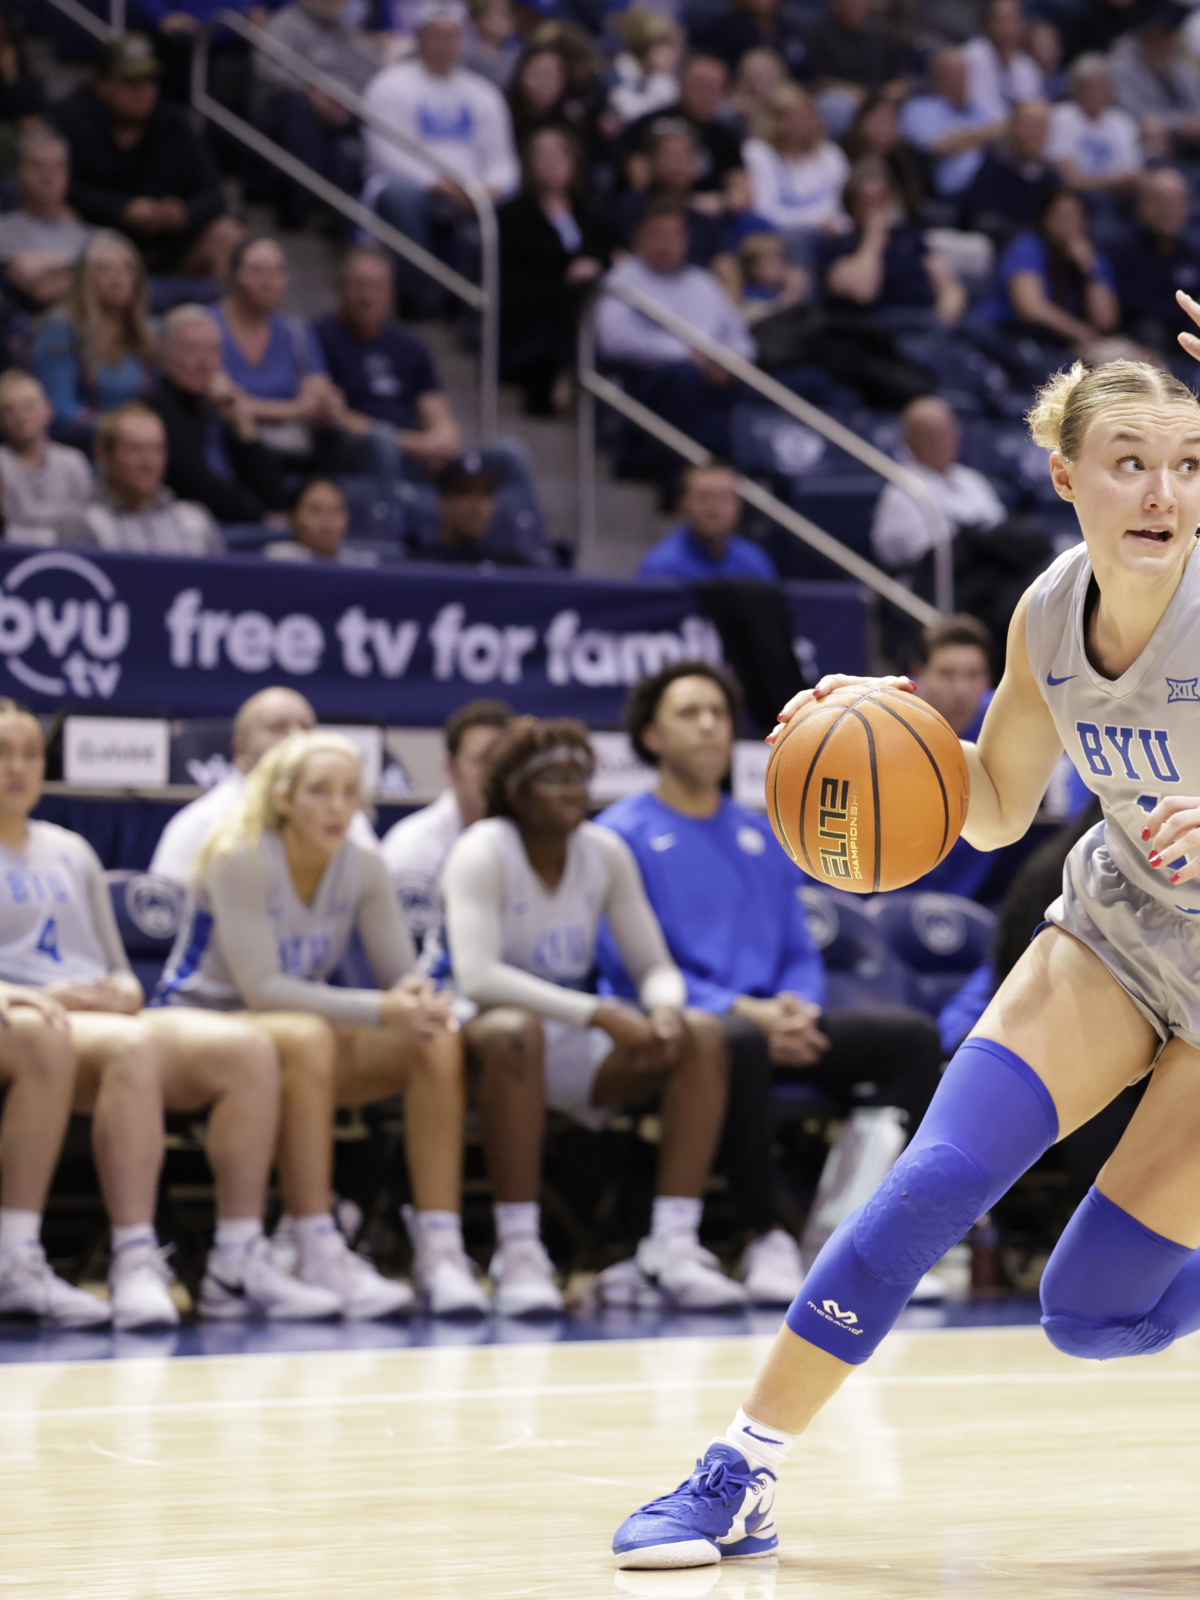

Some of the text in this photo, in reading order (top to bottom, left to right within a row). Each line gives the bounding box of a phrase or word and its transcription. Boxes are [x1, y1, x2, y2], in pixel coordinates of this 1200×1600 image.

[166, 588, 324, 675] free
[336, 605, 420, 679] tv
[430, 602, 536, 684] for
[62, 652, 121, 699] tv
[1075, 720, 1182, 783] BYU
[818, 777, 853, 879] ELITE
[36, 917, 63, 964] 4
